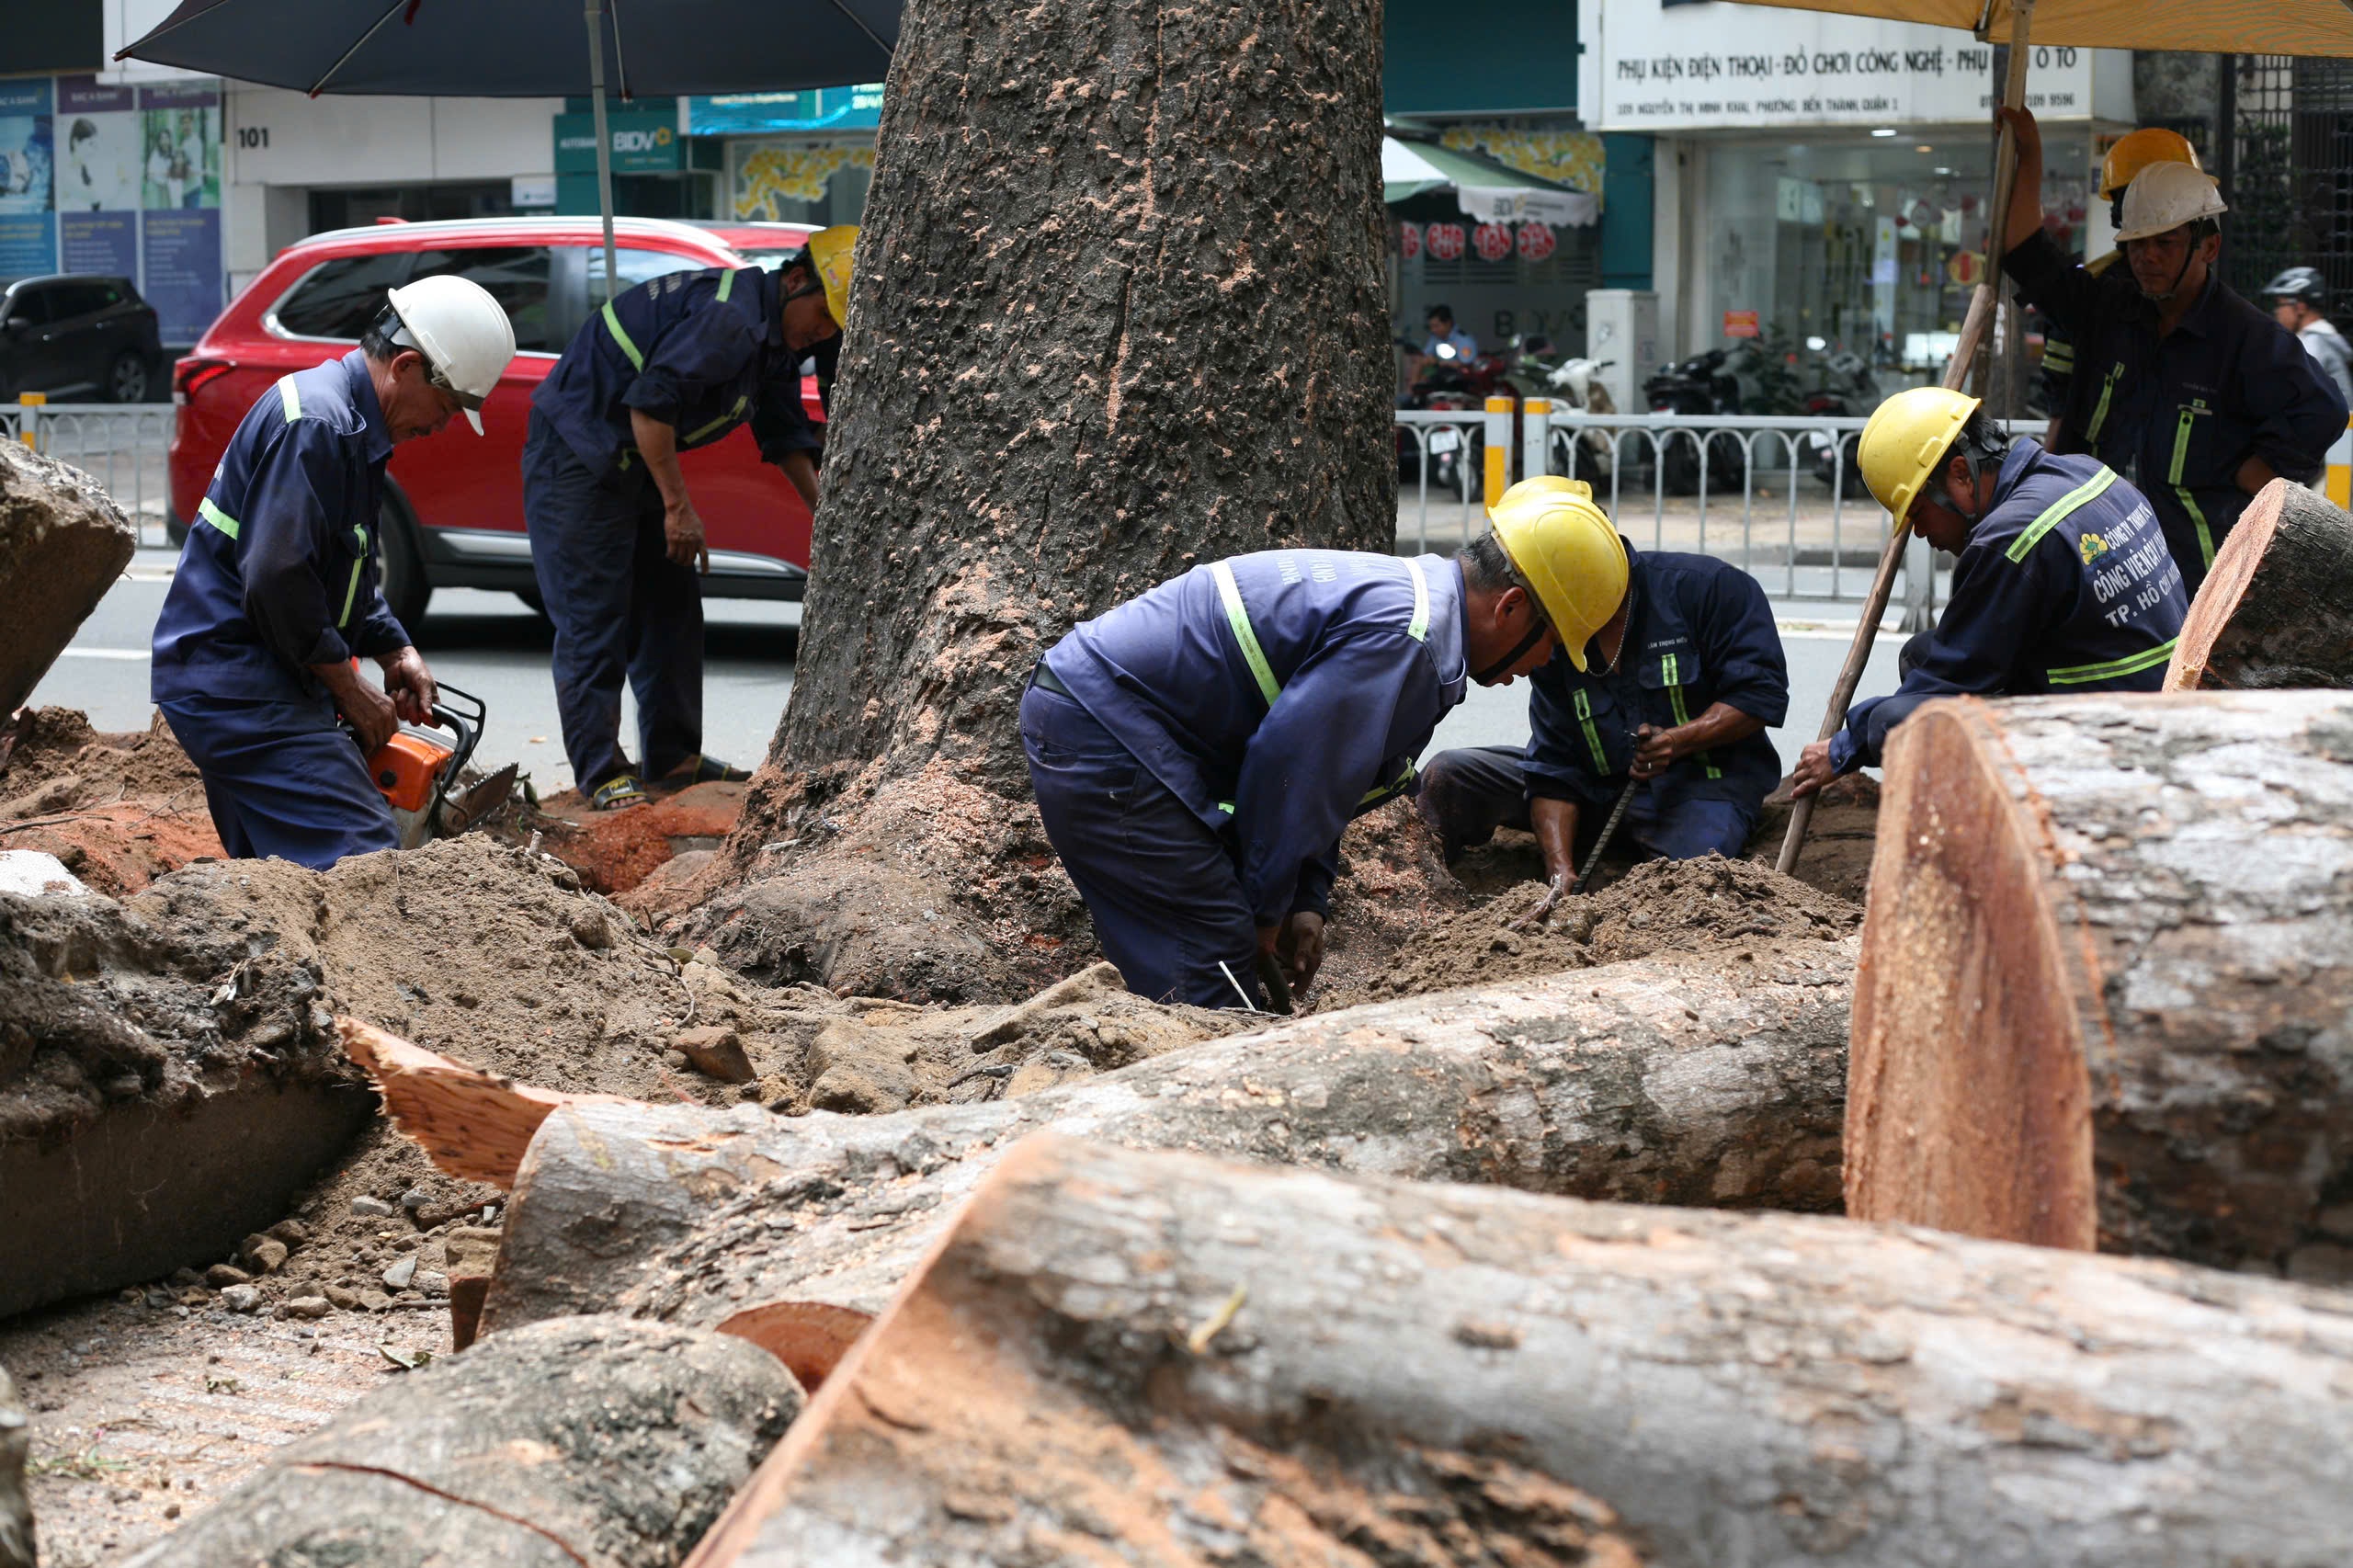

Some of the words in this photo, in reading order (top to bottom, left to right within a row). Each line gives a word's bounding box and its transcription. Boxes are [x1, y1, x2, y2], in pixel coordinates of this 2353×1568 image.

[1617, 59, 1646, 85] PHỤ
[1652, 53, 1683, 84] KIỆN
[1688, 51, 1722, 83] ĐIỆN
[1728, 54, 1773, 81] THOẠI
[1783, 44, 1808, 75] ĐỒ
[1813, 51, 1851, 74] CHƠI
[1856, 46, 1899, 74] CÔNG
[1904, 45, 1944, 77] NGHỆ
[1957, 50, 1988, 76] PHỤ
[237, 127, 269, 149] 101
[559, 137, 597, 149] AUTOBAN
[613, 131, 655, 152] BIDV
[2103, 527, 2127, 551] CÔNG
[2093, 564, 2131, 604] CÔNG
[2122, 547, 2154, 582] VIÊN
[2104, 604, 2138, 629] TP.
[2136, 580, 2161, 611] HỒ
